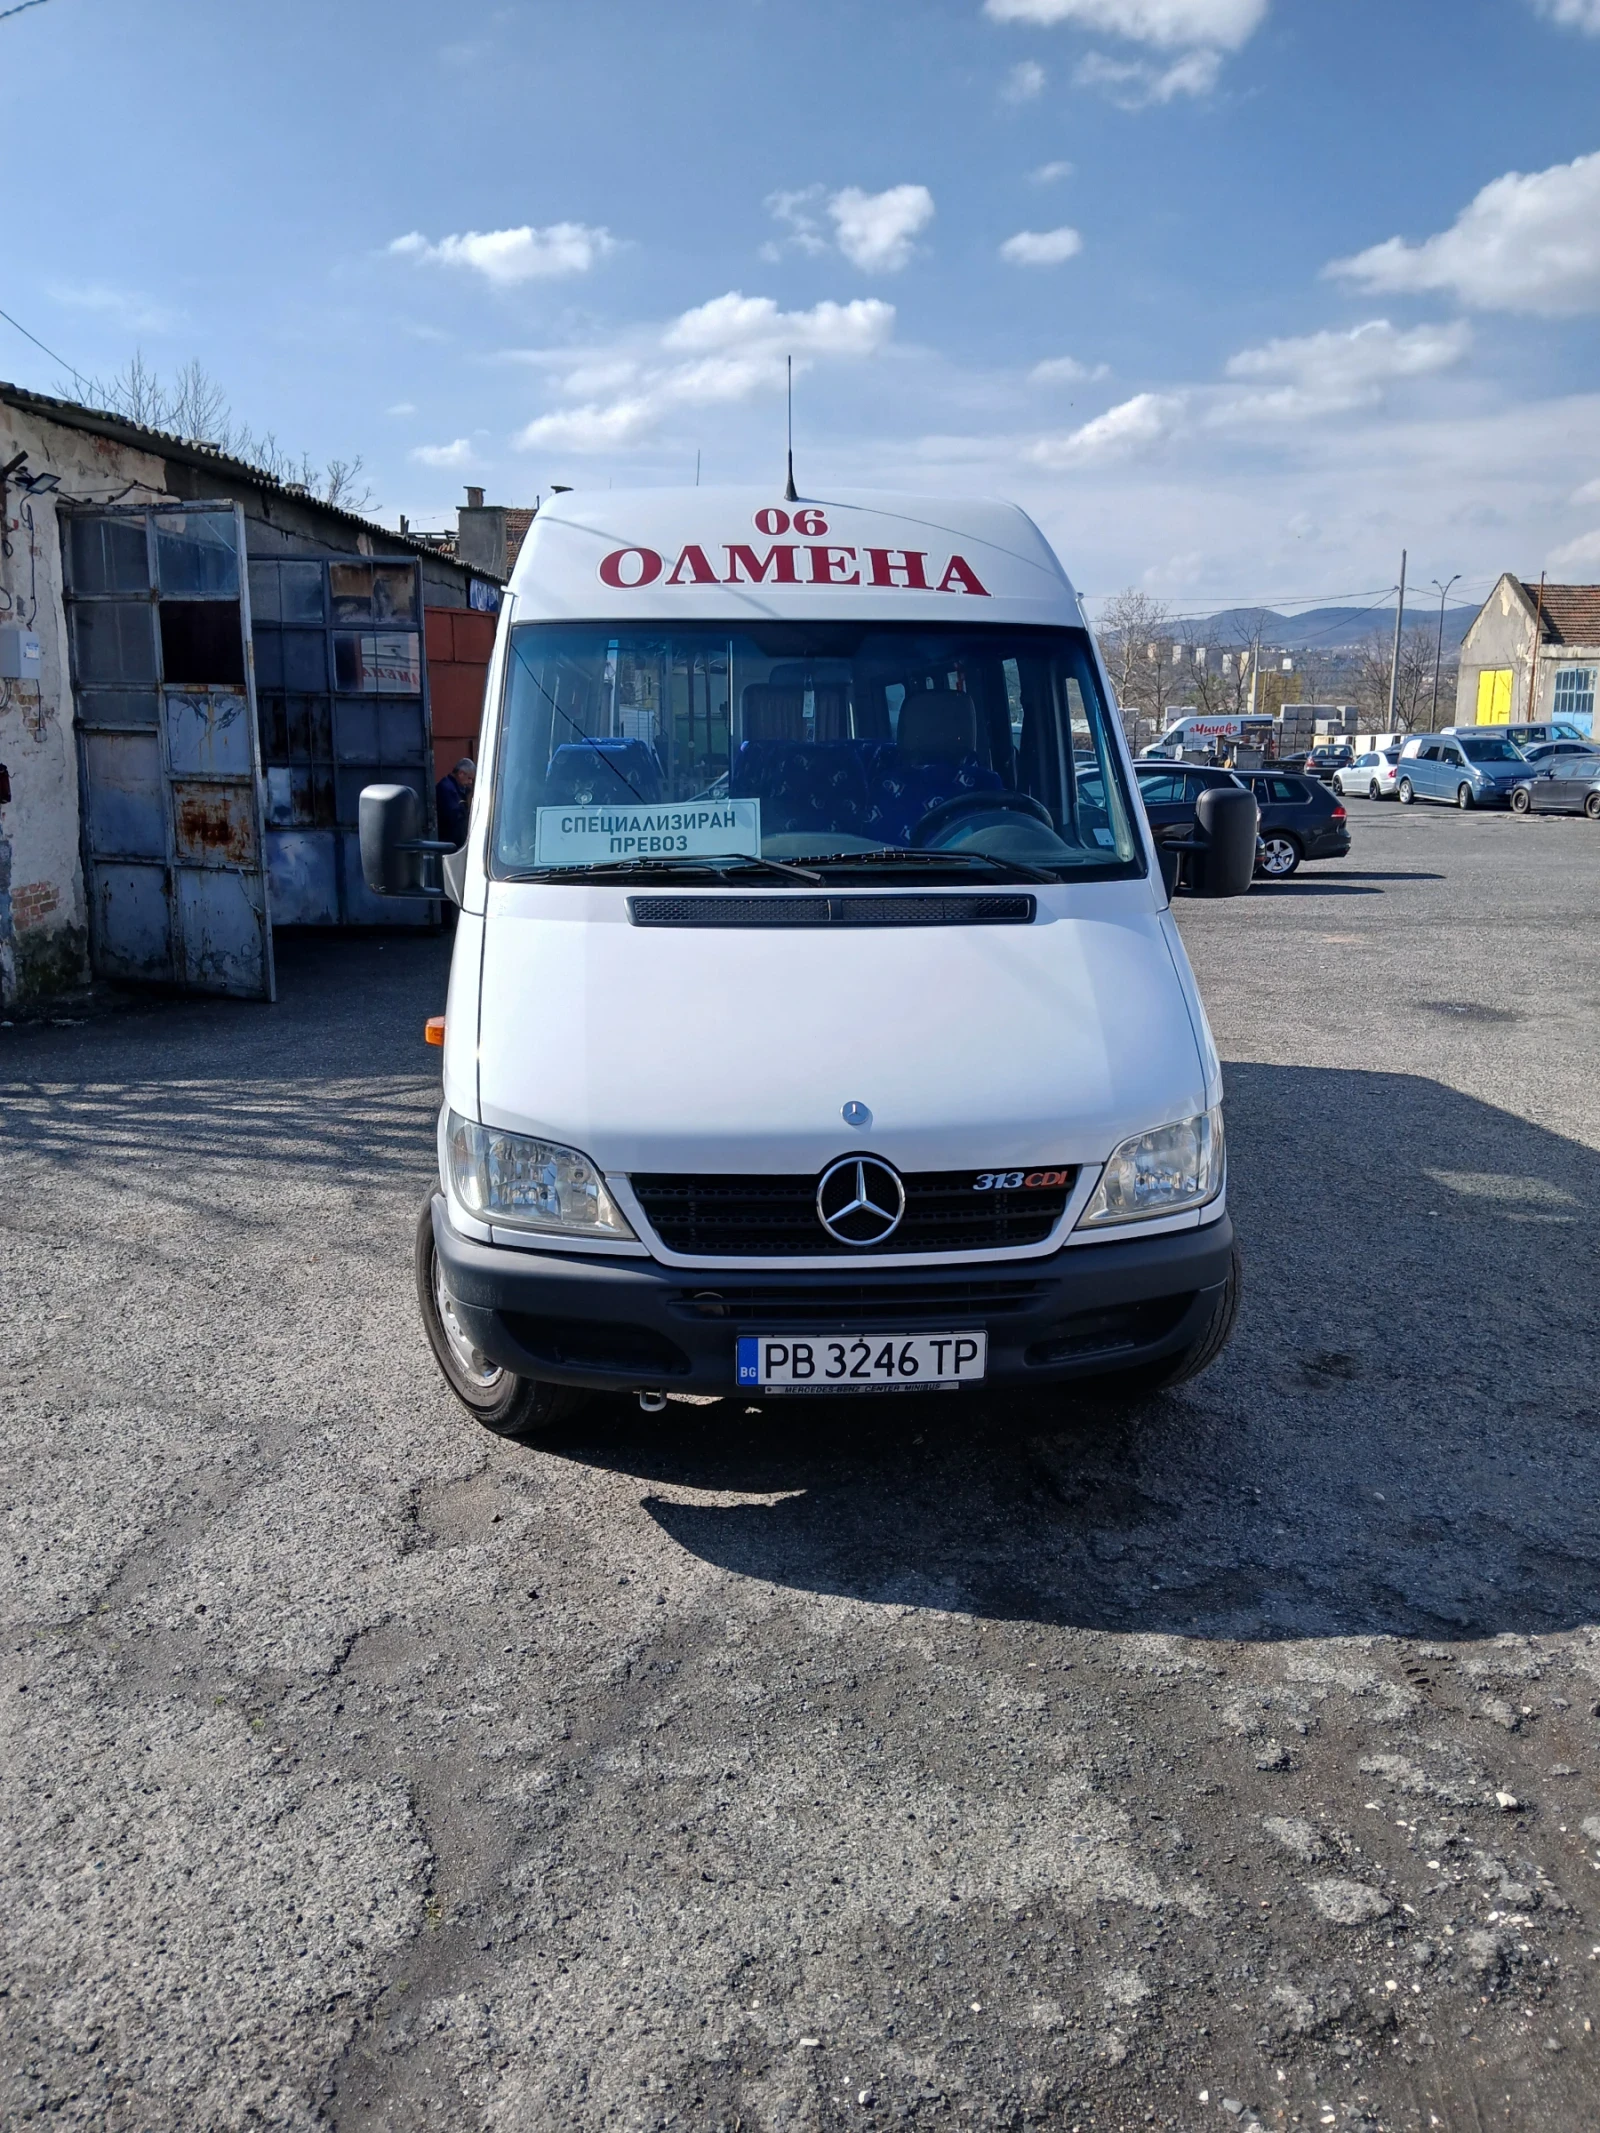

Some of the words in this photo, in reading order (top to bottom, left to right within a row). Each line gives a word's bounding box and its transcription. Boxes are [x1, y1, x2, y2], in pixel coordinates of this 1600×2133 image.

[753, 507, 829, 537] 06
[599, 544, 992, 598] ОЛМЕНА
[560, 811, 736, 835] СПЕЦИАЛИЗИРАН
[610, 835, 688, 853] ПРЕВОЗ
[972, 1172, 1025, 1190] 313
[1025, 1171, 1068, 1187] CDI
[765, 1343, 815, 1379] PB
[825, 1341, 919, 1378] 3246
[930, 1339, 978, 1375] TP
[740, 1366, 757, 1378] BG
